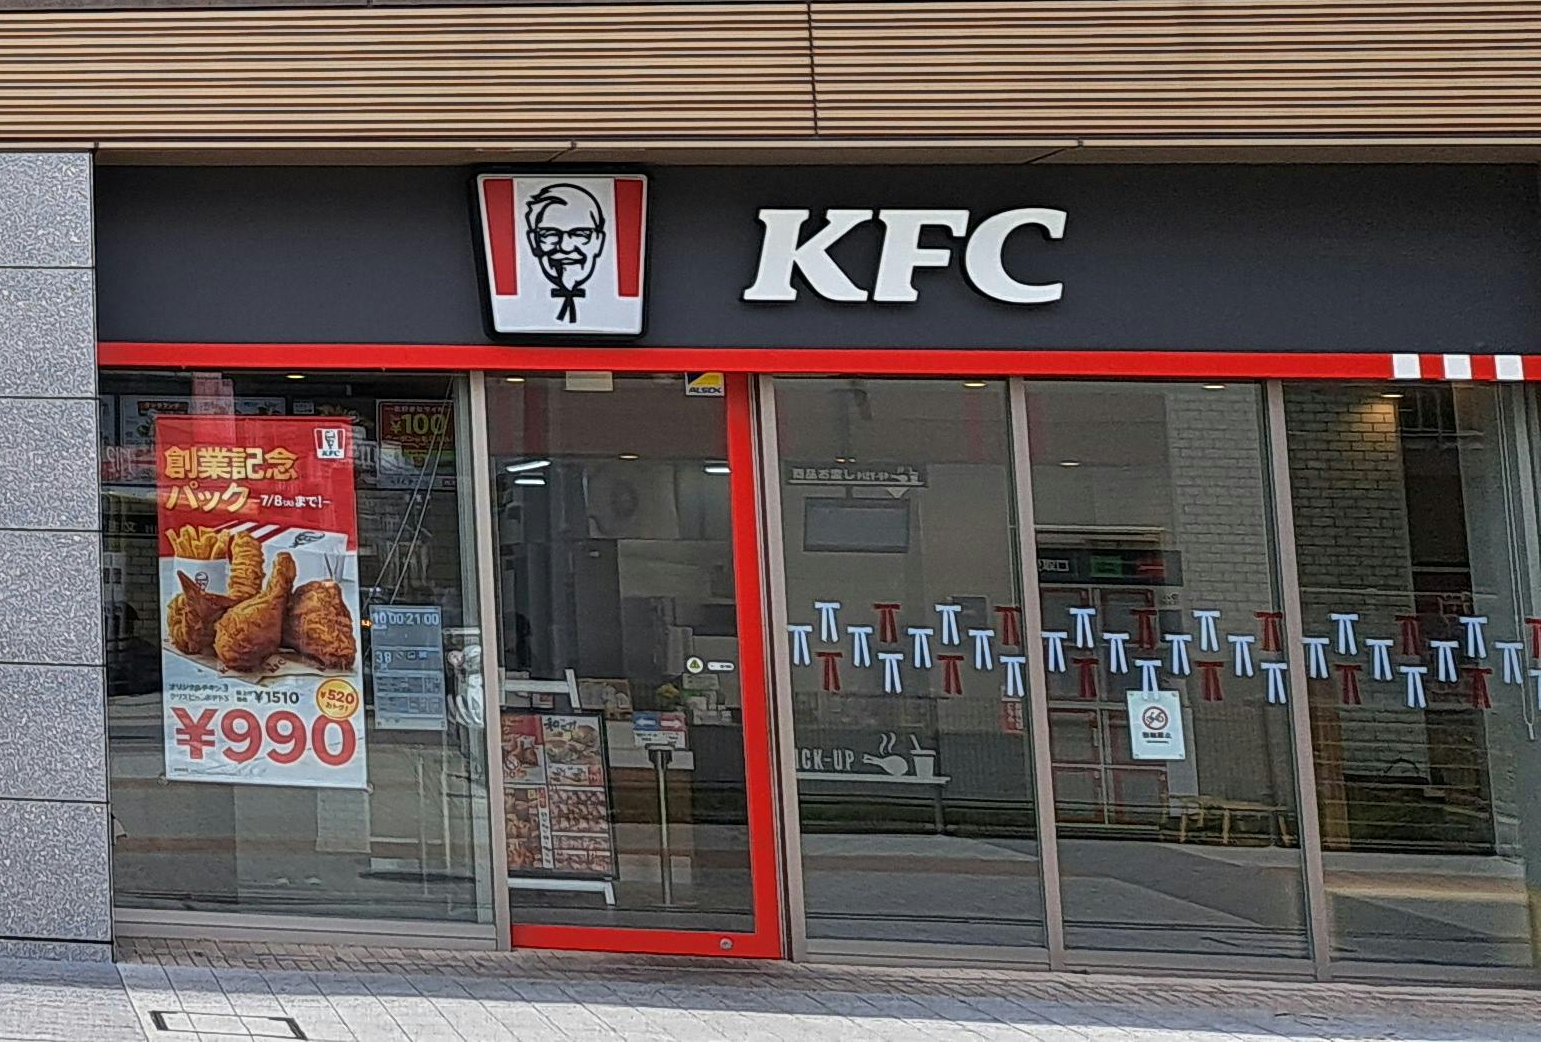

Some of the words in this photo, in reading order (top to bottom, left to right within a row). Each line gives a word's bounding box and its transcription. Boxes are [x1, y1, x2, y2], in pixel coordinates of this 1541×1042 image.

[743, 208, 1067, 303] KFC
[164, 446, 299, 480] 創業記念
[165, 481, 249, 512] パック
[320, 689, 355, 705] ¥520
[171, 707, 357, 767] ¥990
